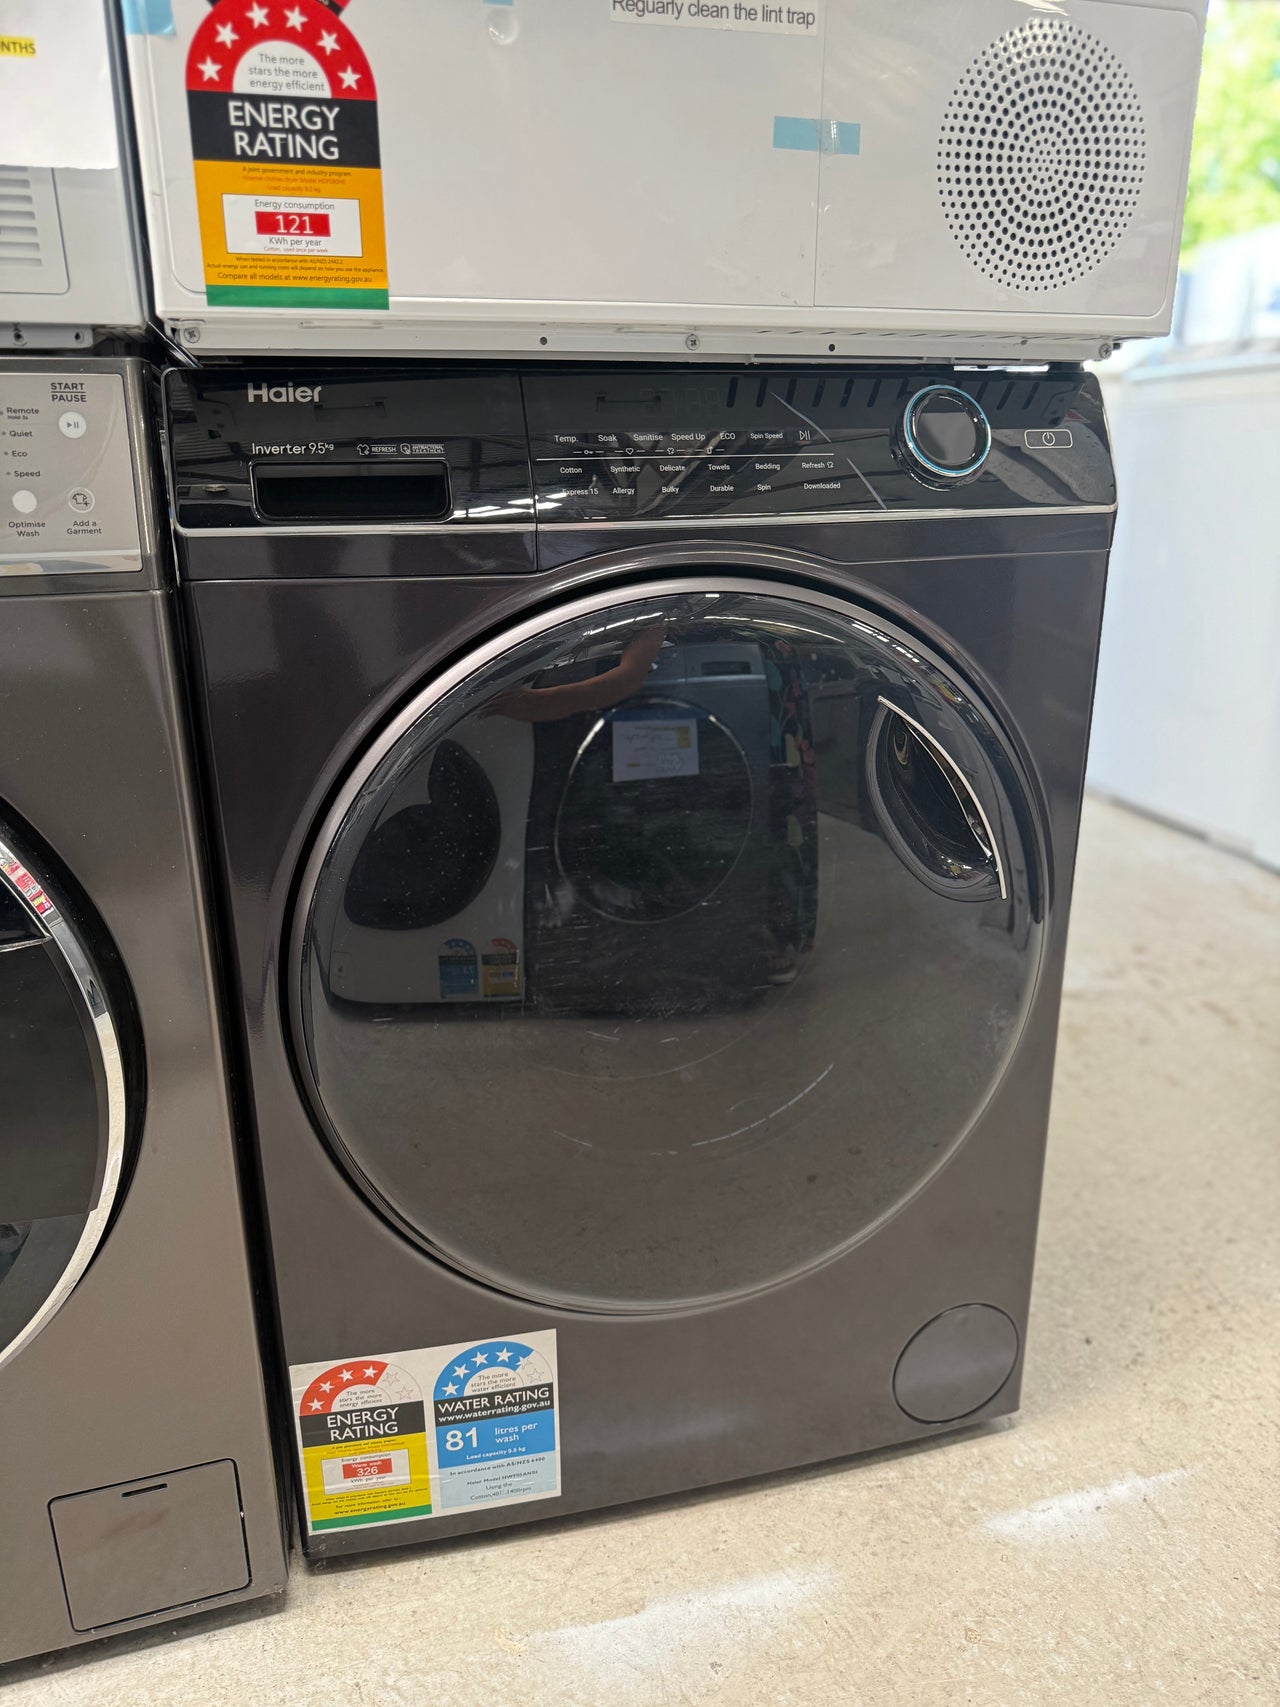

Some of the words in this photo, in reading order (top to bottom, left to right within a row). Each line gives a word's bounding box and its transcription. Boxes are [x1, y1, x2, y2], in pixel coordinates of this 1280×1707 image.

[612, 0, 684, 20] Reguarly
[688, 3, 729, 19] clean
[734, 3, 757, 21] the
[762, 5, 783, 23] lint
[786, 10, 816, 29] trap
[0, 41, 36, 55] NTHS
[259, 54, 277, 64] The
[279, 57, 305, 65] more
[248, 66, 272, 76] stars
[274, 67, 290, 77] the
[292, 70, 318, 78] more
[250, 79, 283, 91] energy
[286, 80, 324, 92] efficient
[228, 100, 340, 131] ENERGY
[234, 131, 339, 160] RATING
[254, 200, 282, 211] Energy
[284, 201, 335, 212] consumption
[276, 215, 314, 234] 121
[269, 236, 288, 246] KWh
[290, 239, 303, 248] per
[305, 240, 322, 249] year
[218, 272, 248, 280] Compare
[292, 276, 373, 284] www.energyrating.gov.au
[50, 382, 86, 391] START
[51, 394, 88, 402] PAUSE
[247, 382, 322, 404] Haier
[6, 407, 40, 415] Remote
[9, 430, 32, 438] Quiet
[598, 434, 618, 442] Soak
[633, 433, 664, 442] Sanitise
[672, 433, 694, 444] Speed
[695, 432, 706, 443] Up
[750, 432, 764, 441] Spin
[765, 432, 784, 440] Speed
[554, 435, 578, 444] Temp.
[252, 442, 306, 455] Inverter
[12, 450, 28, 458] Eco
[560, 466, 583, 474] Cotton
[610, 466, 641, 475] Synthetic
[660, 464, 686, 472] Delicate
[755, 464, 781, 472] Bedding
[802, 462, 825, 470] Refresh
[14, 470, 40, 480] Speed
[662, 486, 680, 496] Bulky
[710, 484, 734, 492] Durable
[757, 484, 772, 493] Spin
[804, 482, 841, 491] Downloaded
[562, 488, 588, 498] Express
[612, 487, 635, 497] Allergy
[8, 521, 46, 530] Optimise
[72, 520, 90, 528] Add
[66, 528, 102, 536] Garment
[491, 1382, 516, 1390] efficient
[438, 1398, 490, 1414] WATER
[494, 1387, 550, 1406] RATING
[438, 1399, 551, 1424] www.waterrating.gov.au
[326, 1406, 399, 1428] ENERGY
[330, 1422, 399, 1442] RATING
[494, 1425, 520, 1436] litres
[522, 1422, 538, 1434] per
[445, 1426, 478, 1452] 81
[495, 1434, 520, 1445] wash
[482, 1450, 507, 1459] capacity
[356, 1466, 379, 1477] 326
[457, 1466, 491, 1476] accordance
[484, 1476, 502, 1484] Model
[486, 1482, 502, 1492] Using
